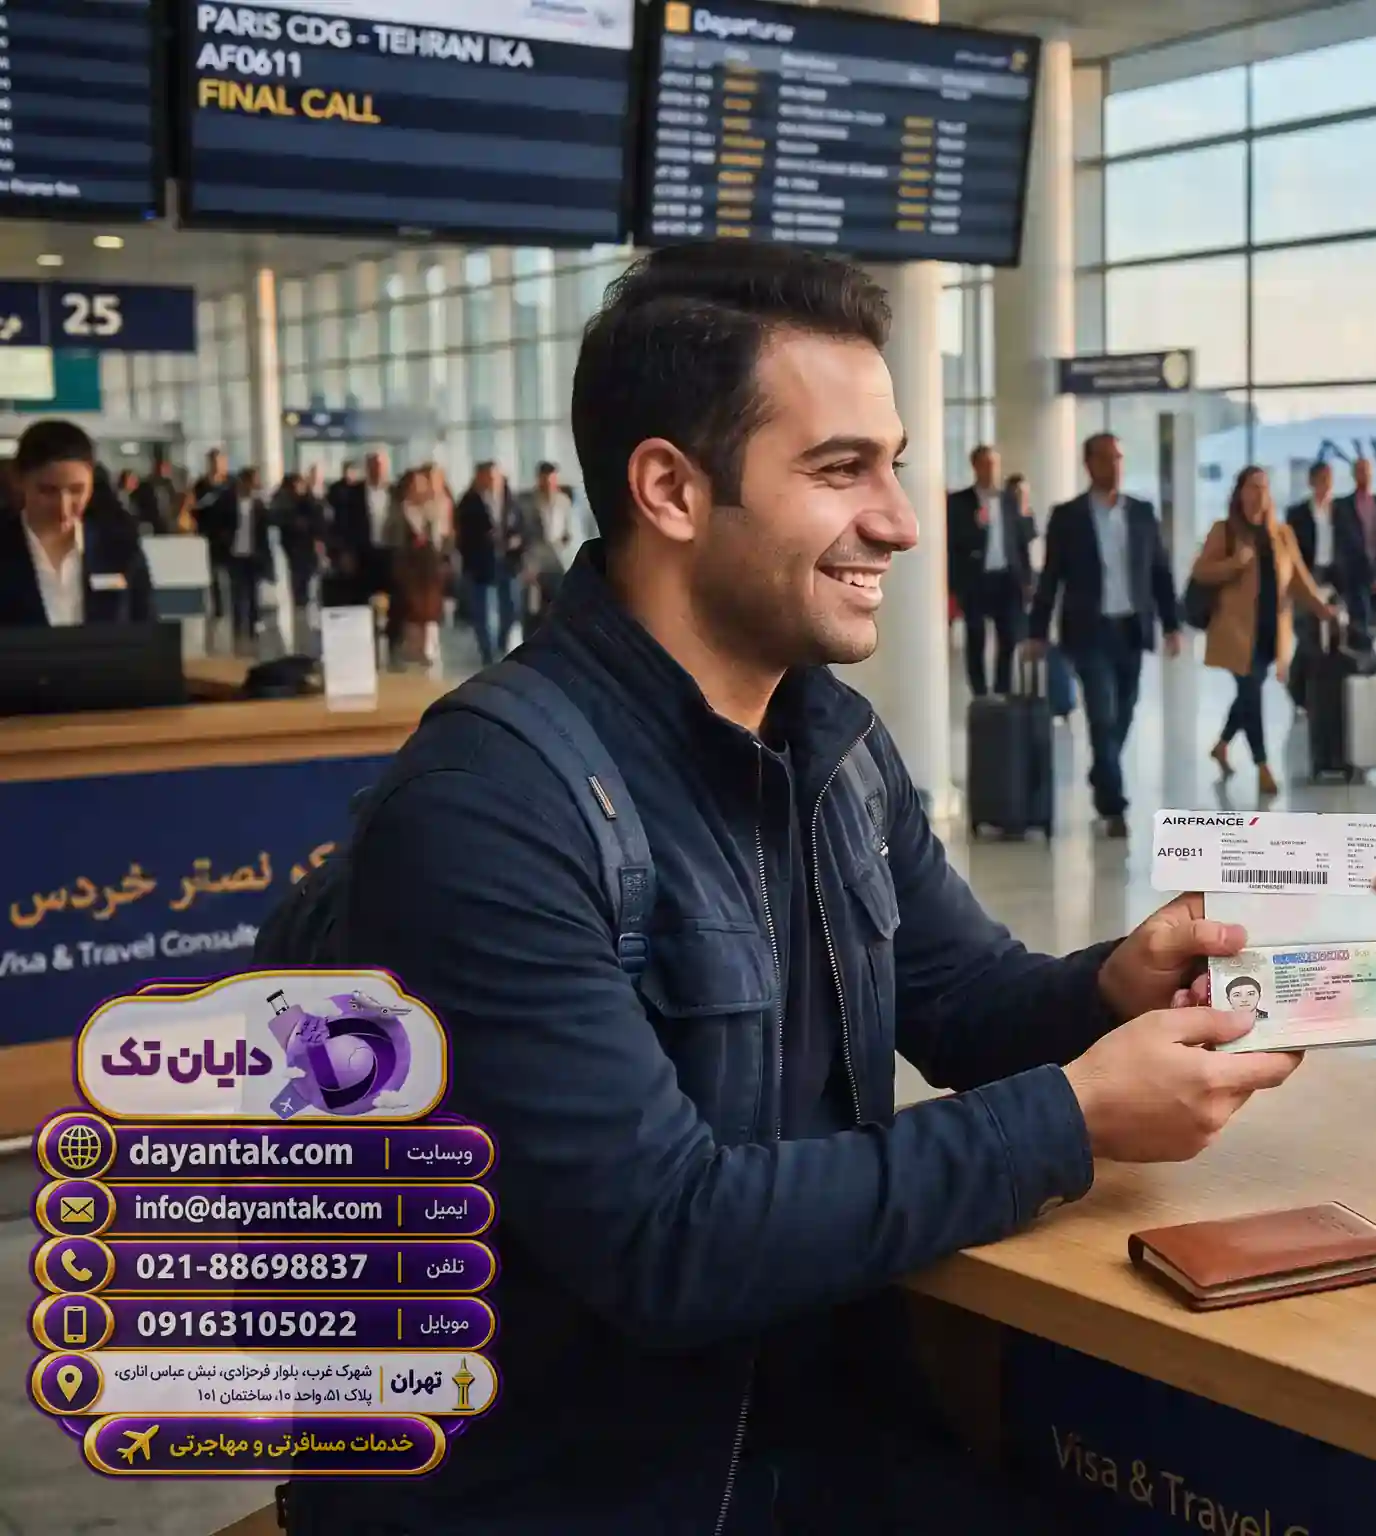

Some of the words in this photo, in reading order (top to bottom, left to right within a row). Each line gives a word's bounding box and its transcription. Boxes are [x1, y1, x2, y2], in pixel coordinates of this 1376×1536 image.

[198, 5, 282, 41] PARIS
[286, 15, 352, 48] CDG
[373, 24, 484, 63] TEHRAN
[489, 37, 534, 68] IKA
[196, 42, 302, 78] AF0611
[198, 78, 296, 116] FINAL
[301, 88, 381, 124] CALL
[61, 292, 123, 336] 25
[1162, 817, 1244, 826] AIRFRANCE
[52, 943, 74, 971] &
[76, 931, 156, 968] Travel
[1051, 1424, 1118, 1492] Visa
[1129, 1459, 1154, 1509] &
[1159, 1468, 1271, 1536] Travel
